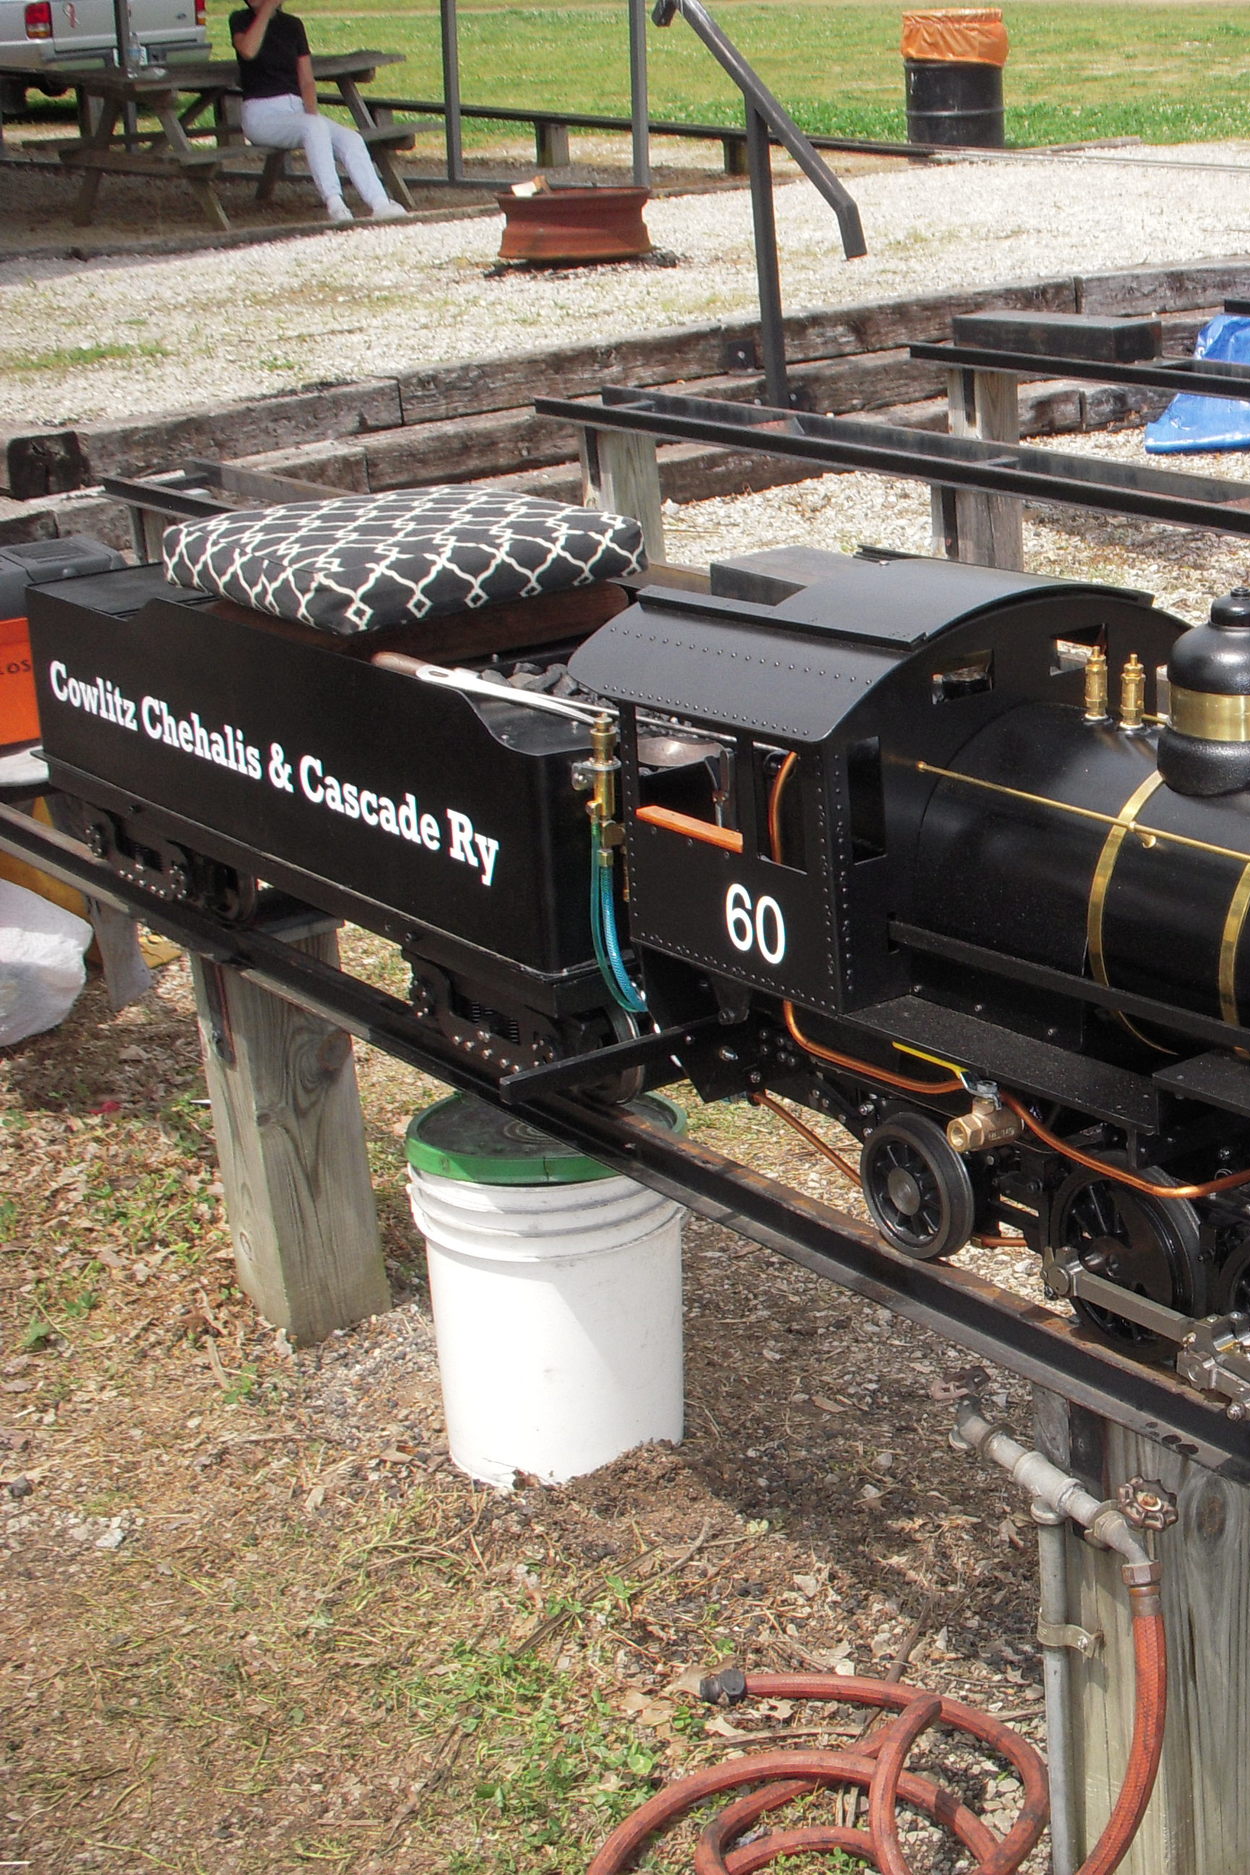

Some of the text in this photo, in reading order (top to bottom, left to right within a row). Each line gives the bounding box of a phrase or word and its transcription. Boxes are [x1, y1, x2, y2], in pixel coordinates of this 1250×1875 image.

[49, 660, 499, 887] Cowlitz Chehalis & Cascade Ry
[725, 882, 786, 965] 60
